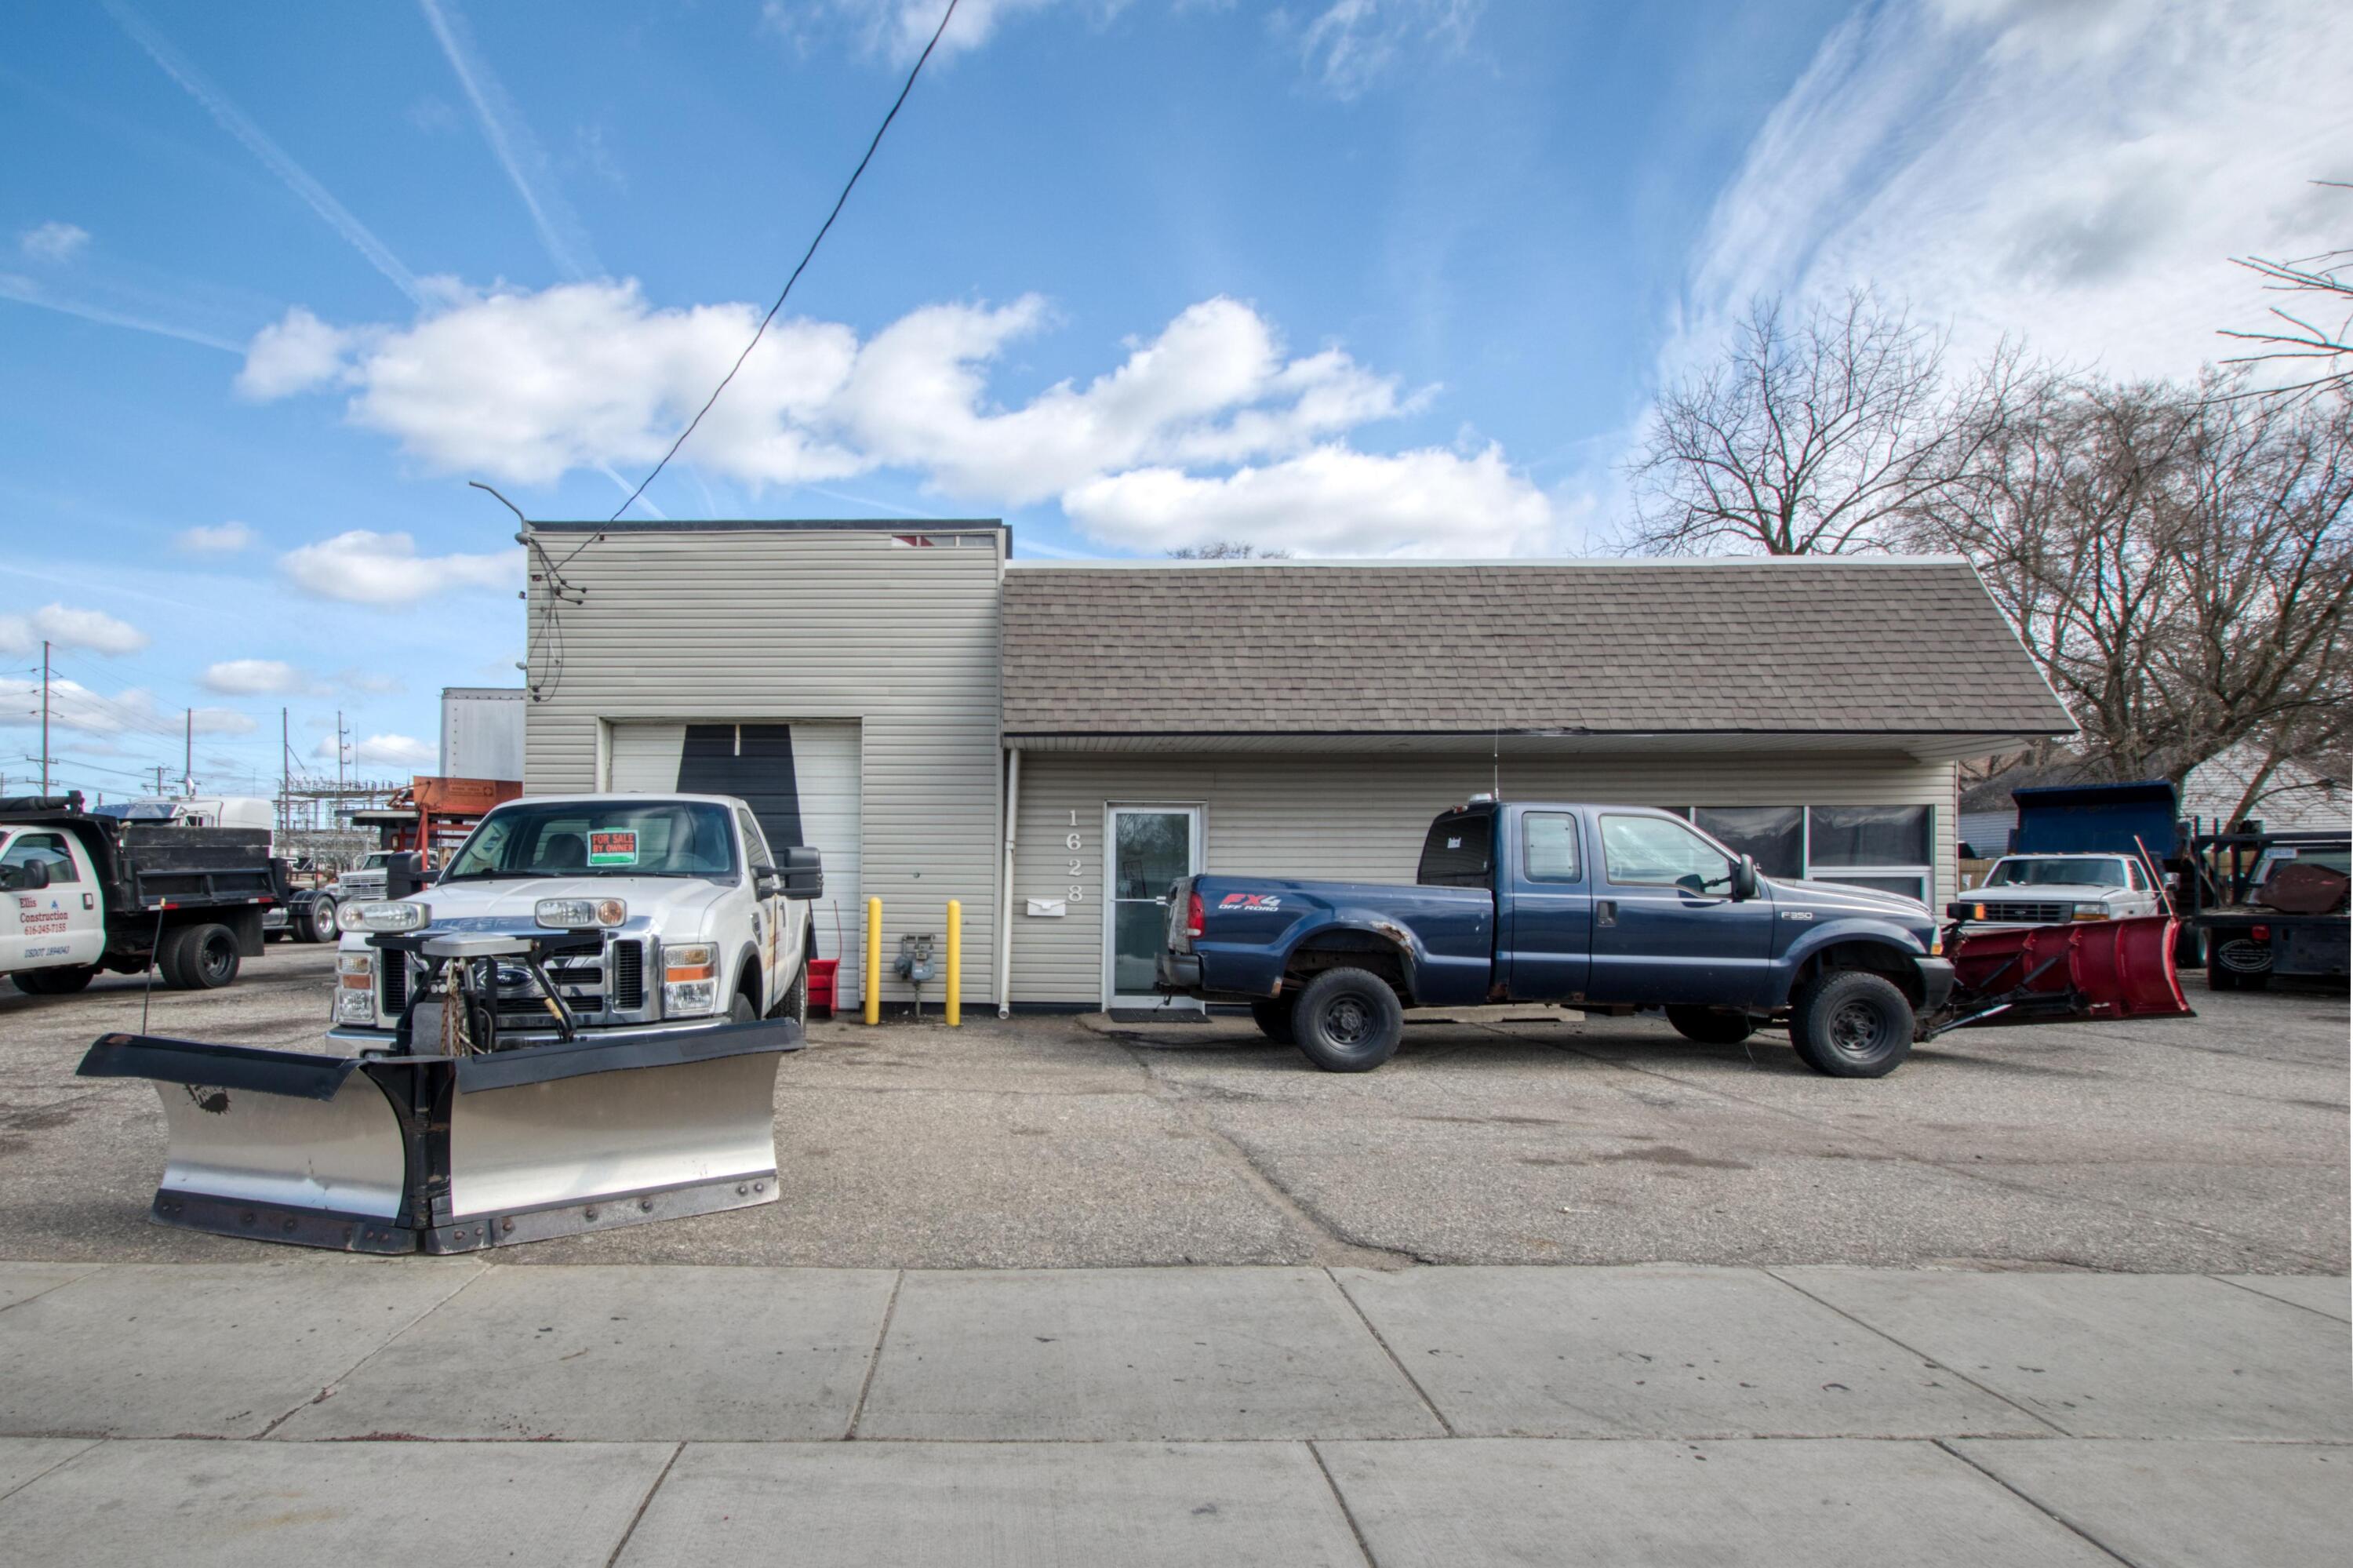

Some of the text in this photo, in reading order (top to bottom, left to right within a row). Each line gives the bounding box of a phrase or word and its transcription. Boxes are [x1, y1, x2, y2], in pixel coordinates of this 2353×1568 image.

[592, 834, 634, 844] FOR SALE
[593, 844, 634, 853] BY OWNER
[1066, 809, 1082, 902] 1628
[19, 897, 37, 908] Ellis
[1221, 893, 1282, 906] FX4
[20, 911, 68, 923] Construction
